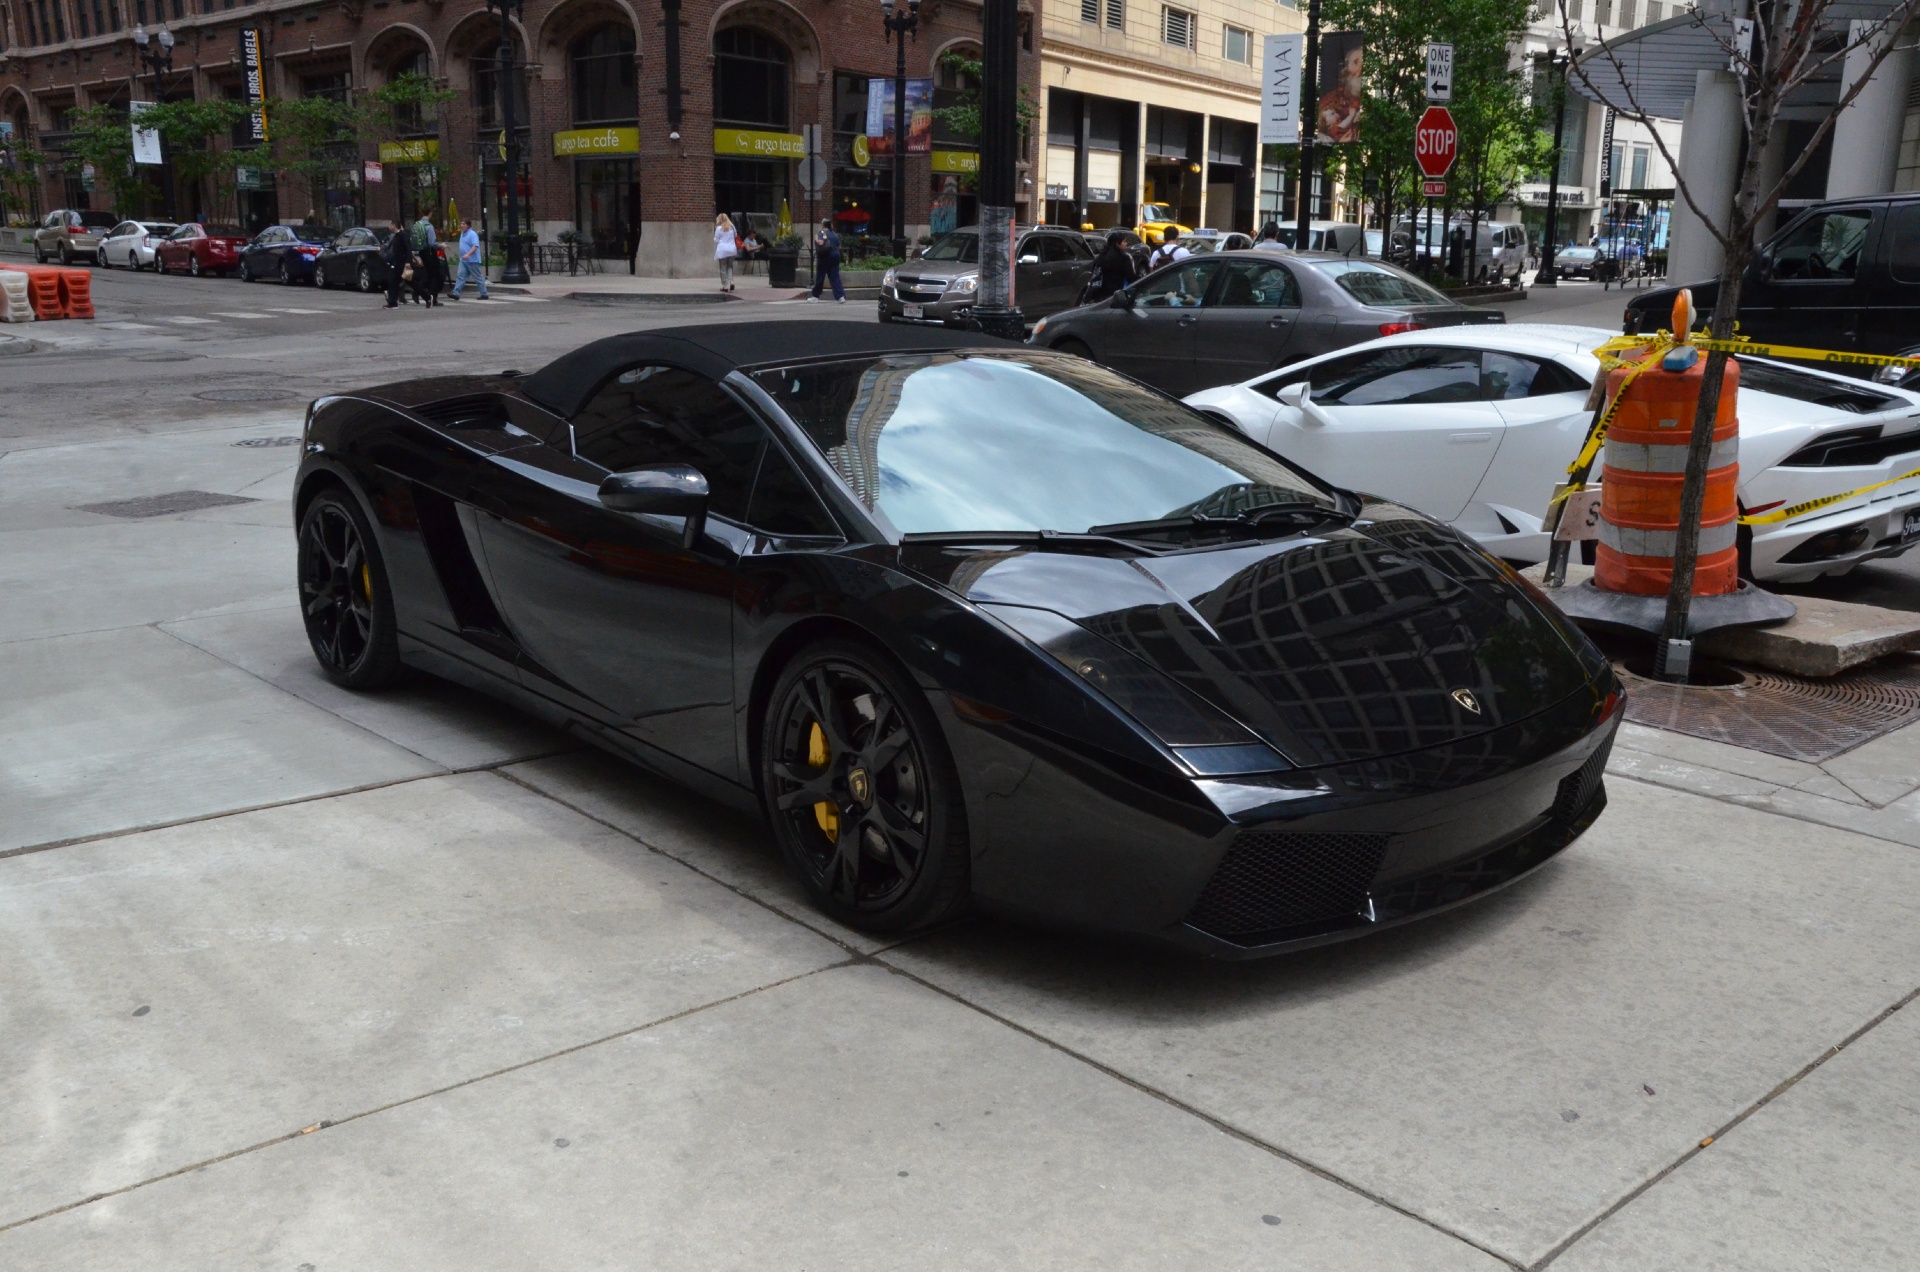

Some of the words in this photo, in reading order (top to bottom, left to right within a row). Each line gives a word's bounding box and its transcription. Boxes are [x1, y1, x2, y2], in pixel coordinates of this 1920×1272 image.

[244, 30, 258, 66] BAGELS
[1430, 48, 1450, 62] ONE
[247, 69, 260, 94] BROS.
[1430, 64, 1450, 77] WAY
[1272, 48, 1292, 122] LUMA
[250, 97, 264, 139] EINSTN
[562, 138, 576, 153] argo
[577, 136, 590, 149] tea
[593, 129, 620, 147] café
[1418, 128, 1454, 155] STOP
[1602, 107, 1614, 157] ORDSTROM
[754, 139, 778, 154] argo
[779, 139, 791, 152] tea
[1601, 158, 1610, 182] rack
[1425, 184, 1433, 193] ALL
[1434, 184, 1444, 193] WAY
